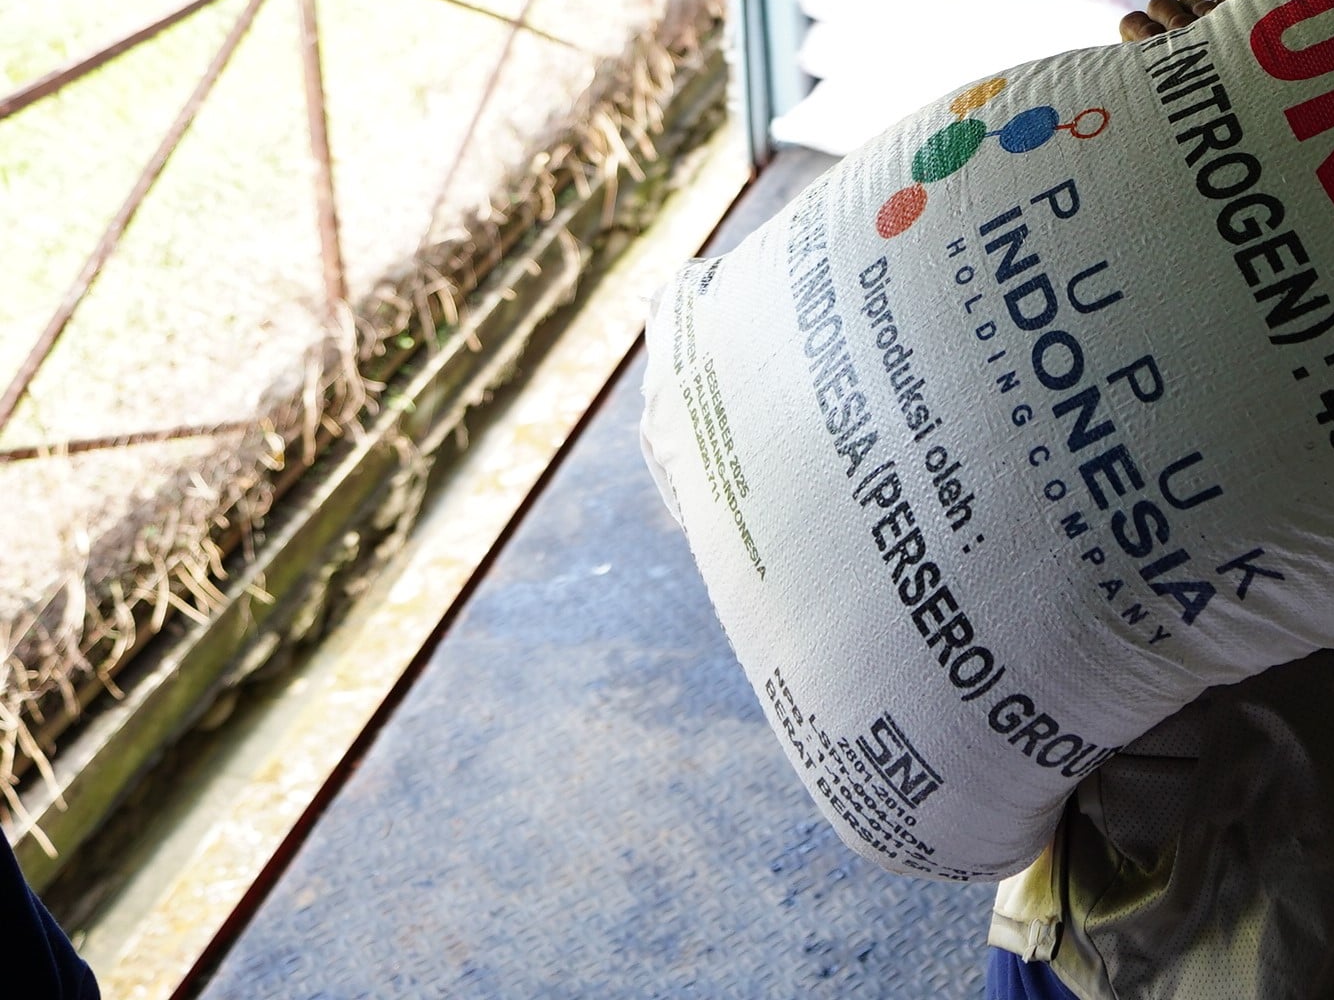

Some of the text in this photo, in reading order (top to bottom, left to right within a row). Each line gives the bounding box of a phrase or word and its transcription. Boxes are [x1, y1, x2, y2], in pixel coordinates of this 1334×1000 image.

[693, 372, 767, 582] PALEMBANG-INDONESIA
[704, 357, 734, 456] DESEMBER
[729, 455, 750, 499] 2025
[791, 256, 878, 479] INDONESIA
[852, 460, 1006, 701] (PERSERO)
[858, 255, 943, 443] Diproduksi
[925, 445, 975, 532] oleh
[945, 237, 1173, 647] HOLDING COMPANY
[979, 205, 1219, 626] INDONESIA
[765, 678, 817, 770] BERAT
[816, 776, 897, 859] BERSIH
[774, 667, 804, 727] NPB
[836, 737, 917, 827] 2801-2010
[870, 717, 940, 805] SNI
